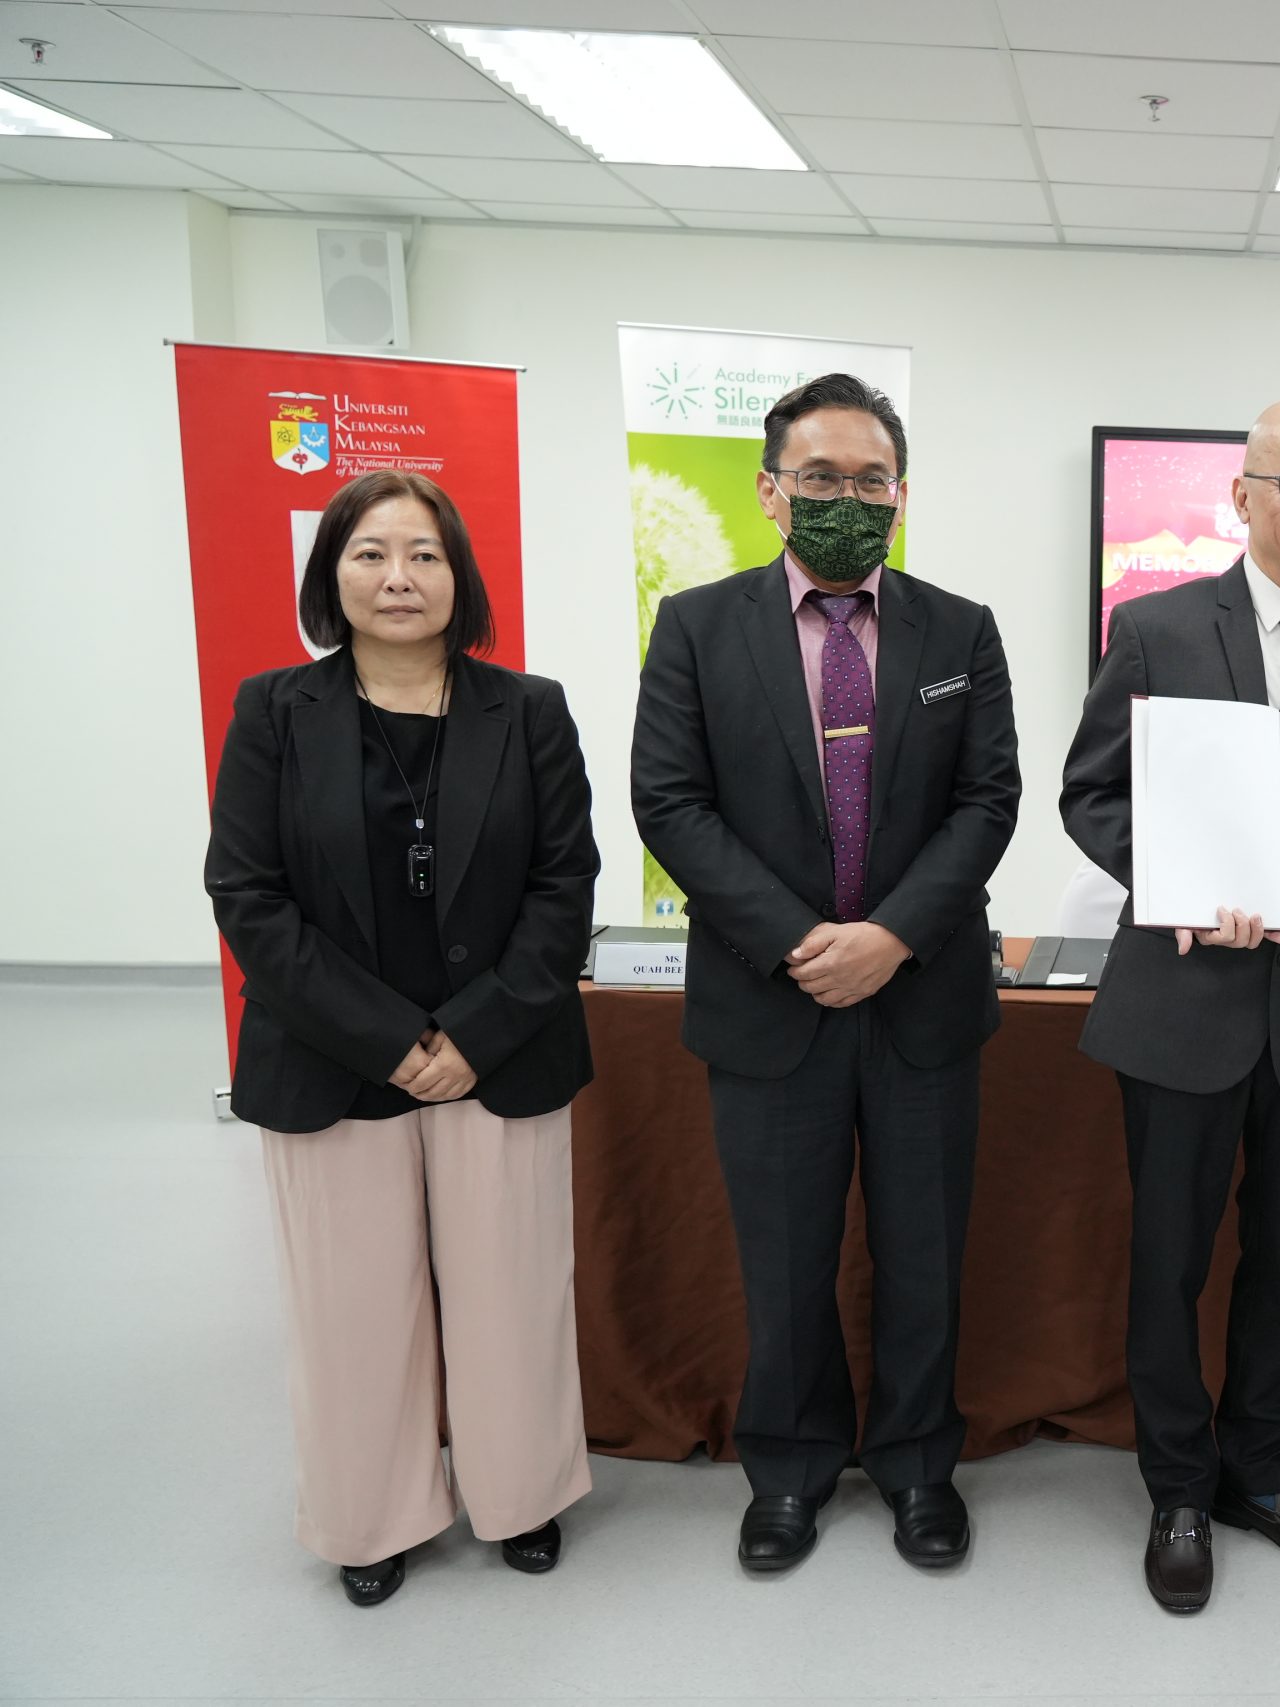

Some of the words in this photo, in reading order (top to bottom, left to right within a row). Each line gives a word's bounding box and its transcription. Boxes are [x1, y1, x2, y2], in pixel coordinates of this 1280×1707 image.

[714, 367, 791, 388] Academy
[797, 372, 815, 385] Fo
[714, 386, 785, 411] Silen
[335, 466, 348, 478] of
[336, 457, 353, 467] The
[355, 457, 395, 469] National
[397, 459, 443, 472] University
[926, 680, 966, 698] HISHAMSHAH
[665, 955, 682, 963] MS.
[633, 966, 662, 975] QUAH
[665, 966, 684, 974] BEE
